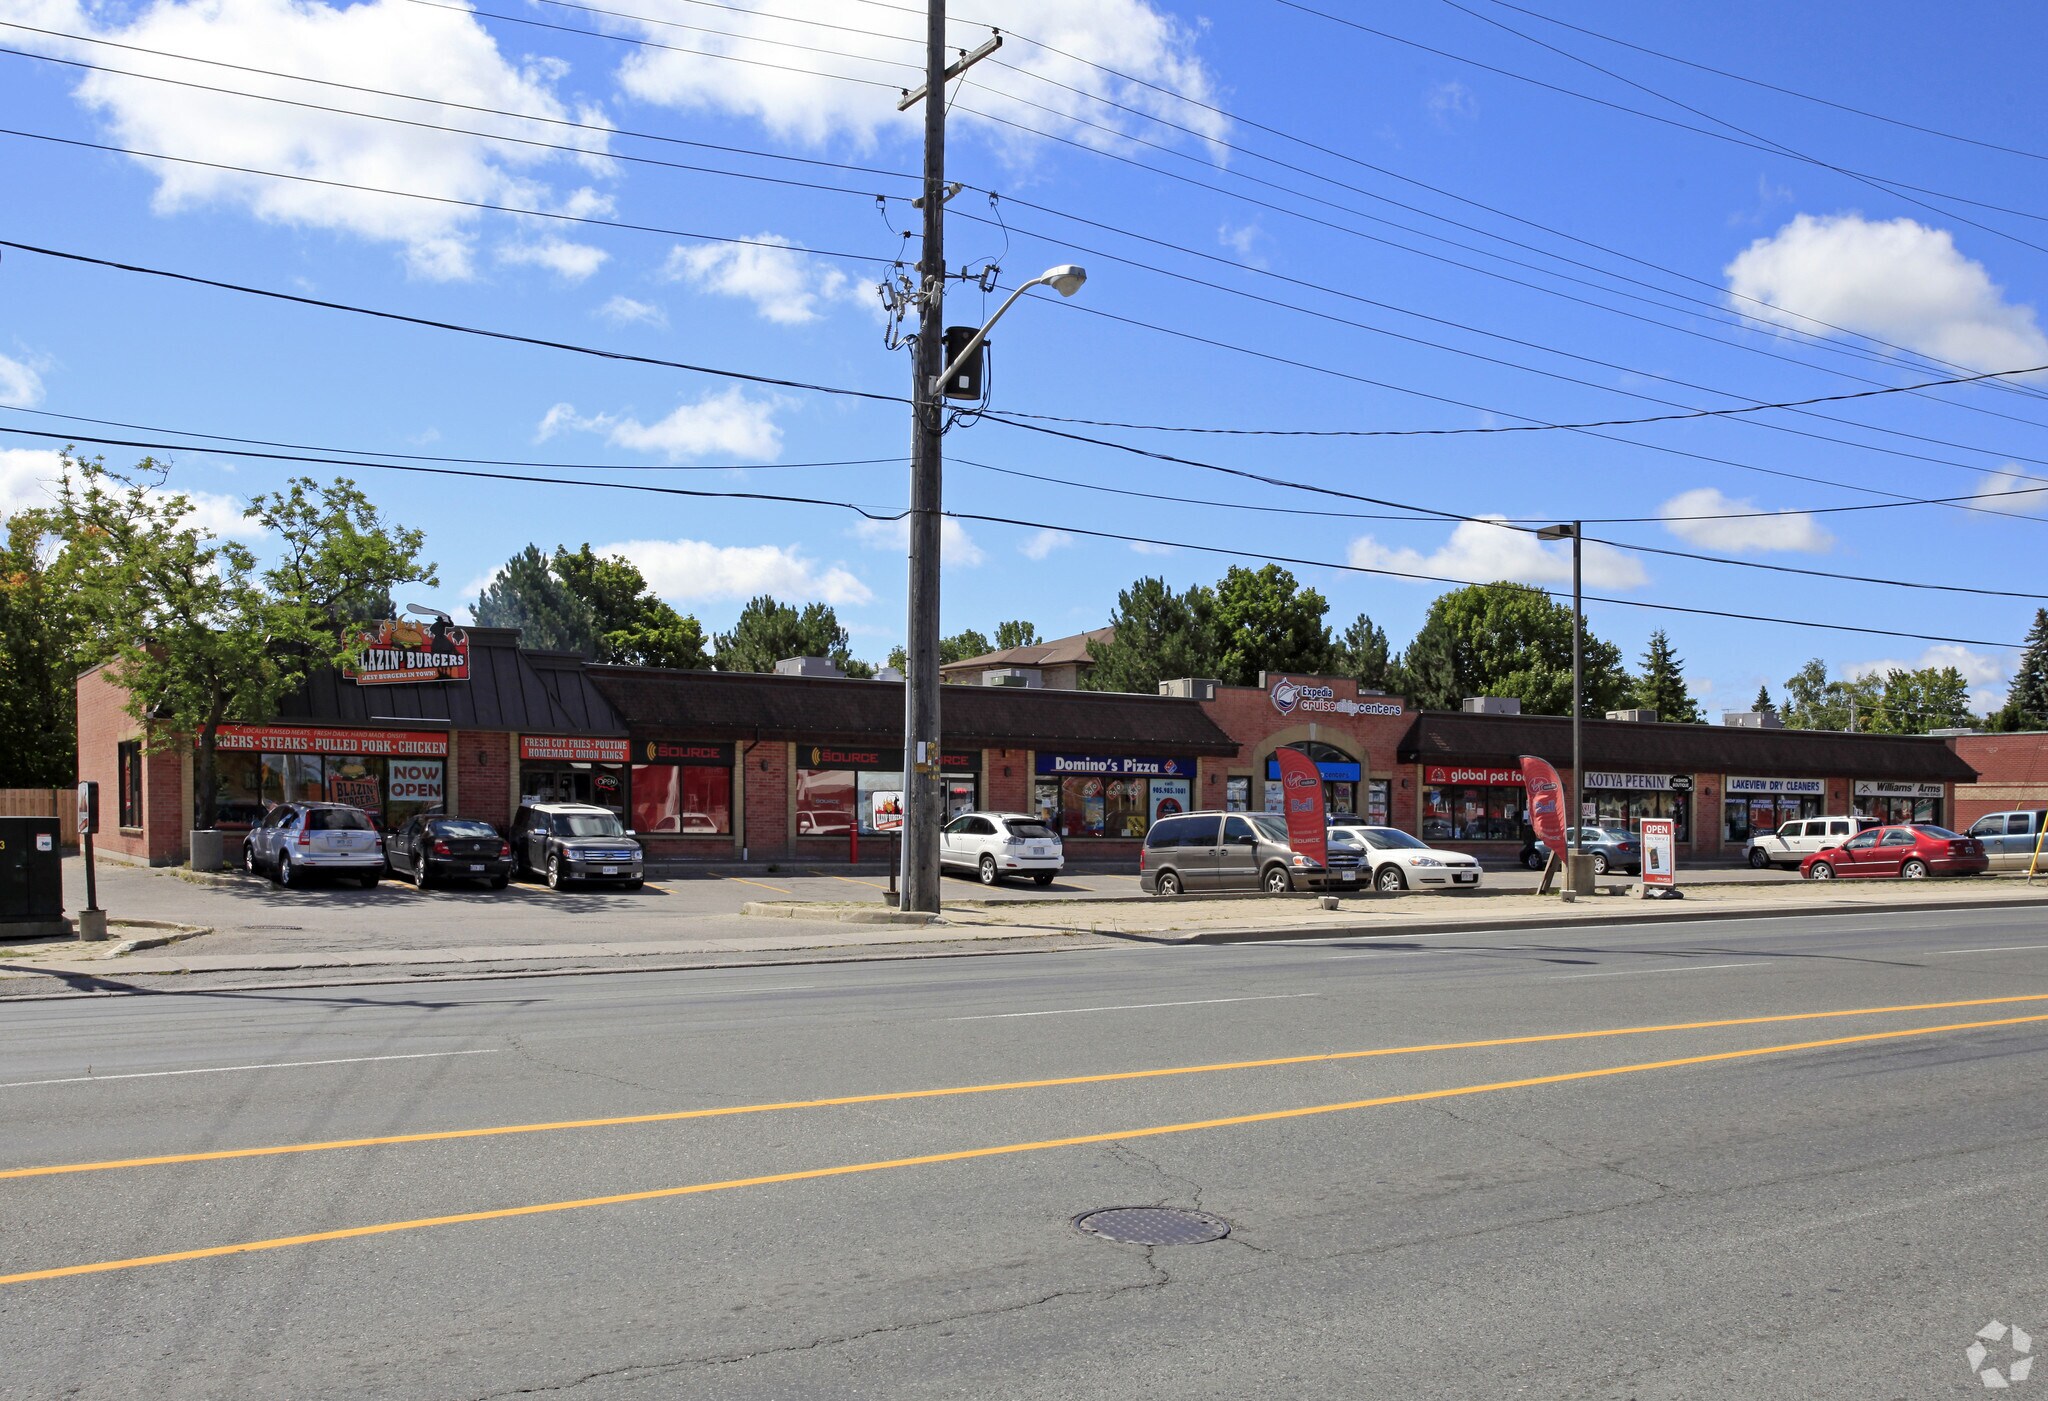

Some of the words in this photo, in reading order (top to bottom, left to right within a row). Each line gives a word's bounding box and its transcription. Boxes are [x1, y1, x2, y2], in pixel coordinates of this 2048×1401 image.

[356, 648, 403, 671] LAZIN'
[406, 651, 464, 669] BURGERS
[378, 672, 406, 680] BURGERS
[1302, 686, 1333, 698] Expedia
[261, 735, 307, 750] STEAKS
[315, 738, 358, 752] PULLED
[361, 740, 392, 753] PORK
[398, 741, 447, 754] CHICKEN
[524, 738, 549, 747] FRESH
[551, 738, 567, 748] CUT
[569, 739, 591, 749] FRIES
[595, 740, 627, 750] POUTINE
[528, 748, 573, 759] HOMEMADE
[575, 750, 599, 759] ONION
[601, 751, 624, 760] RINGS
[658, 746, 720, 758] SOURCE
[822, 752, 879, 763] SOURCE
[1056, 757, 1118, 772] Domino's
[1124, 758, 1159, 773] Pizza
[393, 766, 440, 780] NOW
[1451, 769, 1487, 783] global
[1490, 770, 1508, 784] pet
[1588, 773, 1622, 787] KOTYA
[1732, 780, 1767, 790] LAKEVIEW
[1769, 781, 1784, 790] DRY
[1786, 782, 1820, 791] CLEANERS
[390, 783, 441, 797] OPEN
[1918, 784, 1941, 793] Arms
[1291, 797, 1314, 812] Bell
[1646, 824, 1668, 834] OPEN
